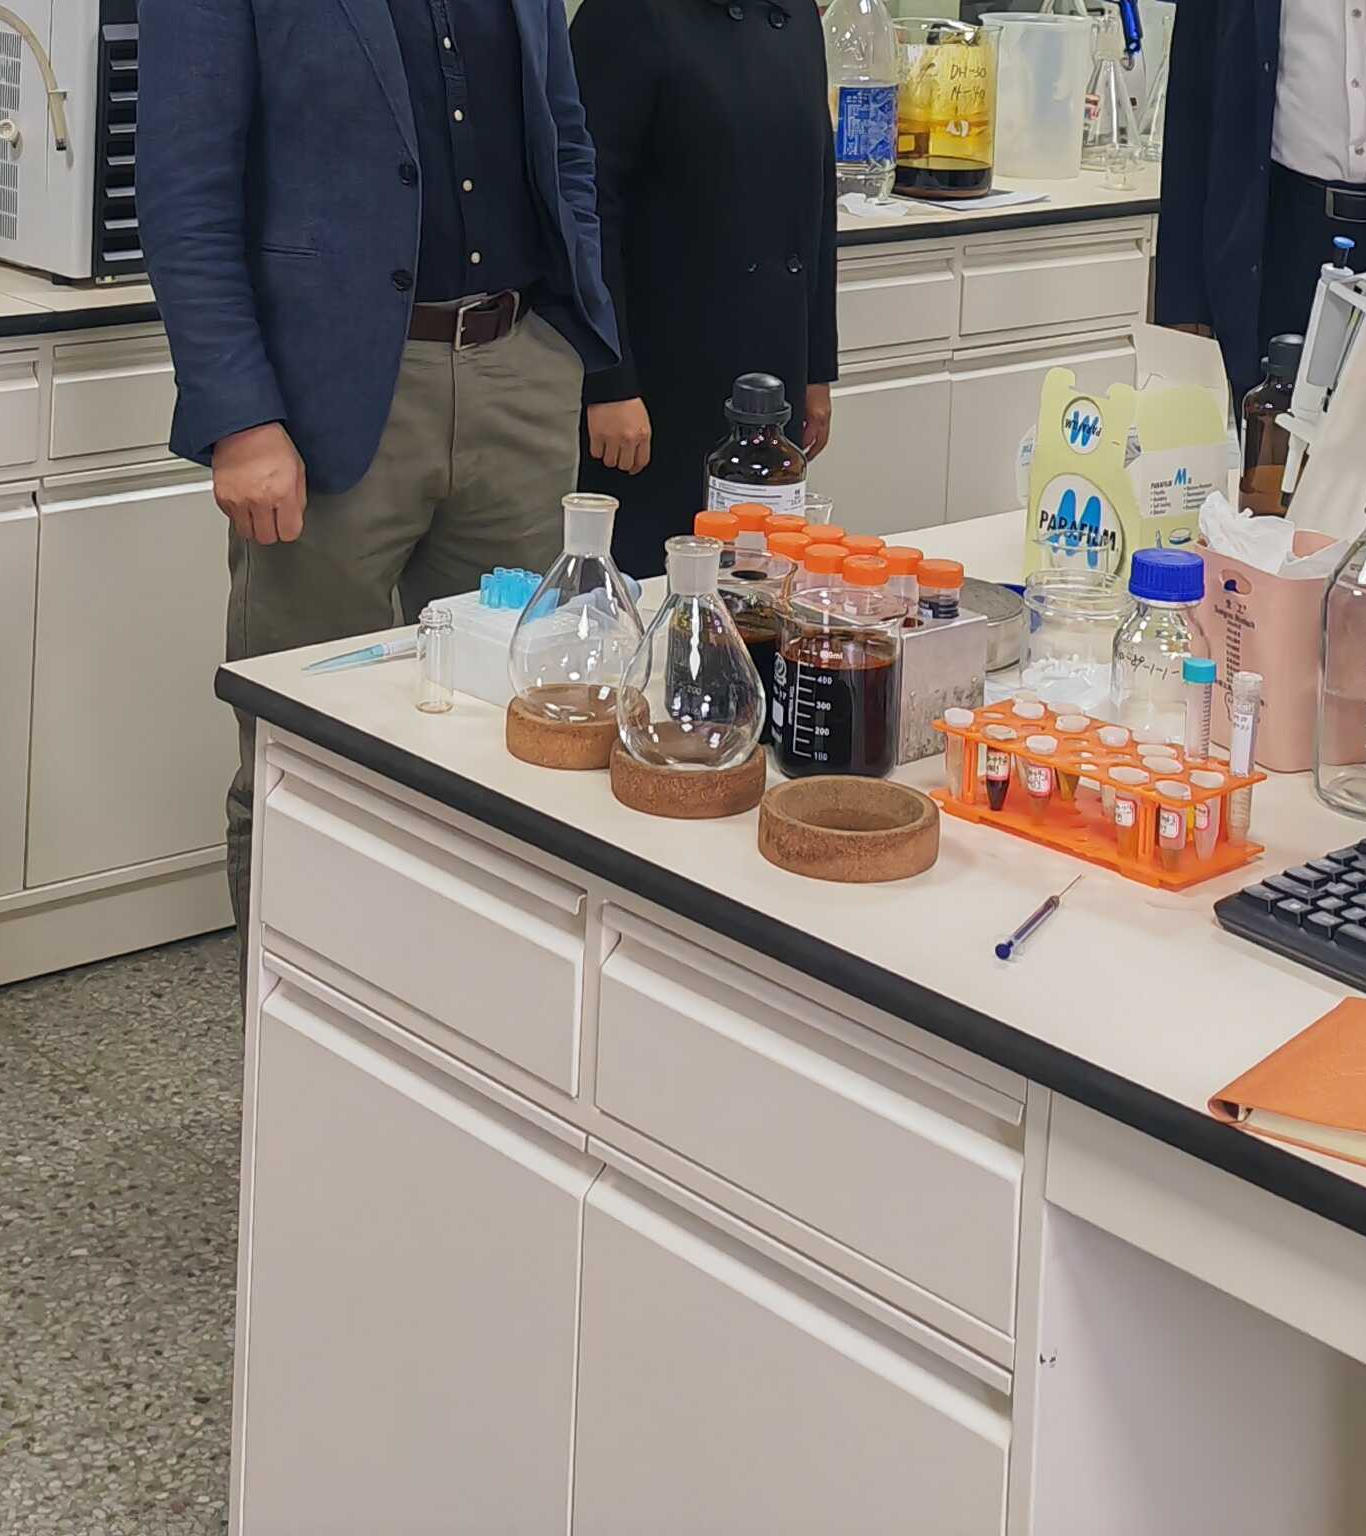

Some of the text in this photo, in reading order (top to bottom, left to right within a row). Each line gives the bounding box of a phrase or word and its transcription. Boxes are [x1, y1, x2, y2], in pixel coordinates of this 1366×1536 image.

[1038, 509, 1117, 552] PARAFILM
[817, 675, 833, 685] 400
[816, 700, 831, 711] 300
[814, 726, 830, 736] 200
[813, 751, 828, 761] 100
